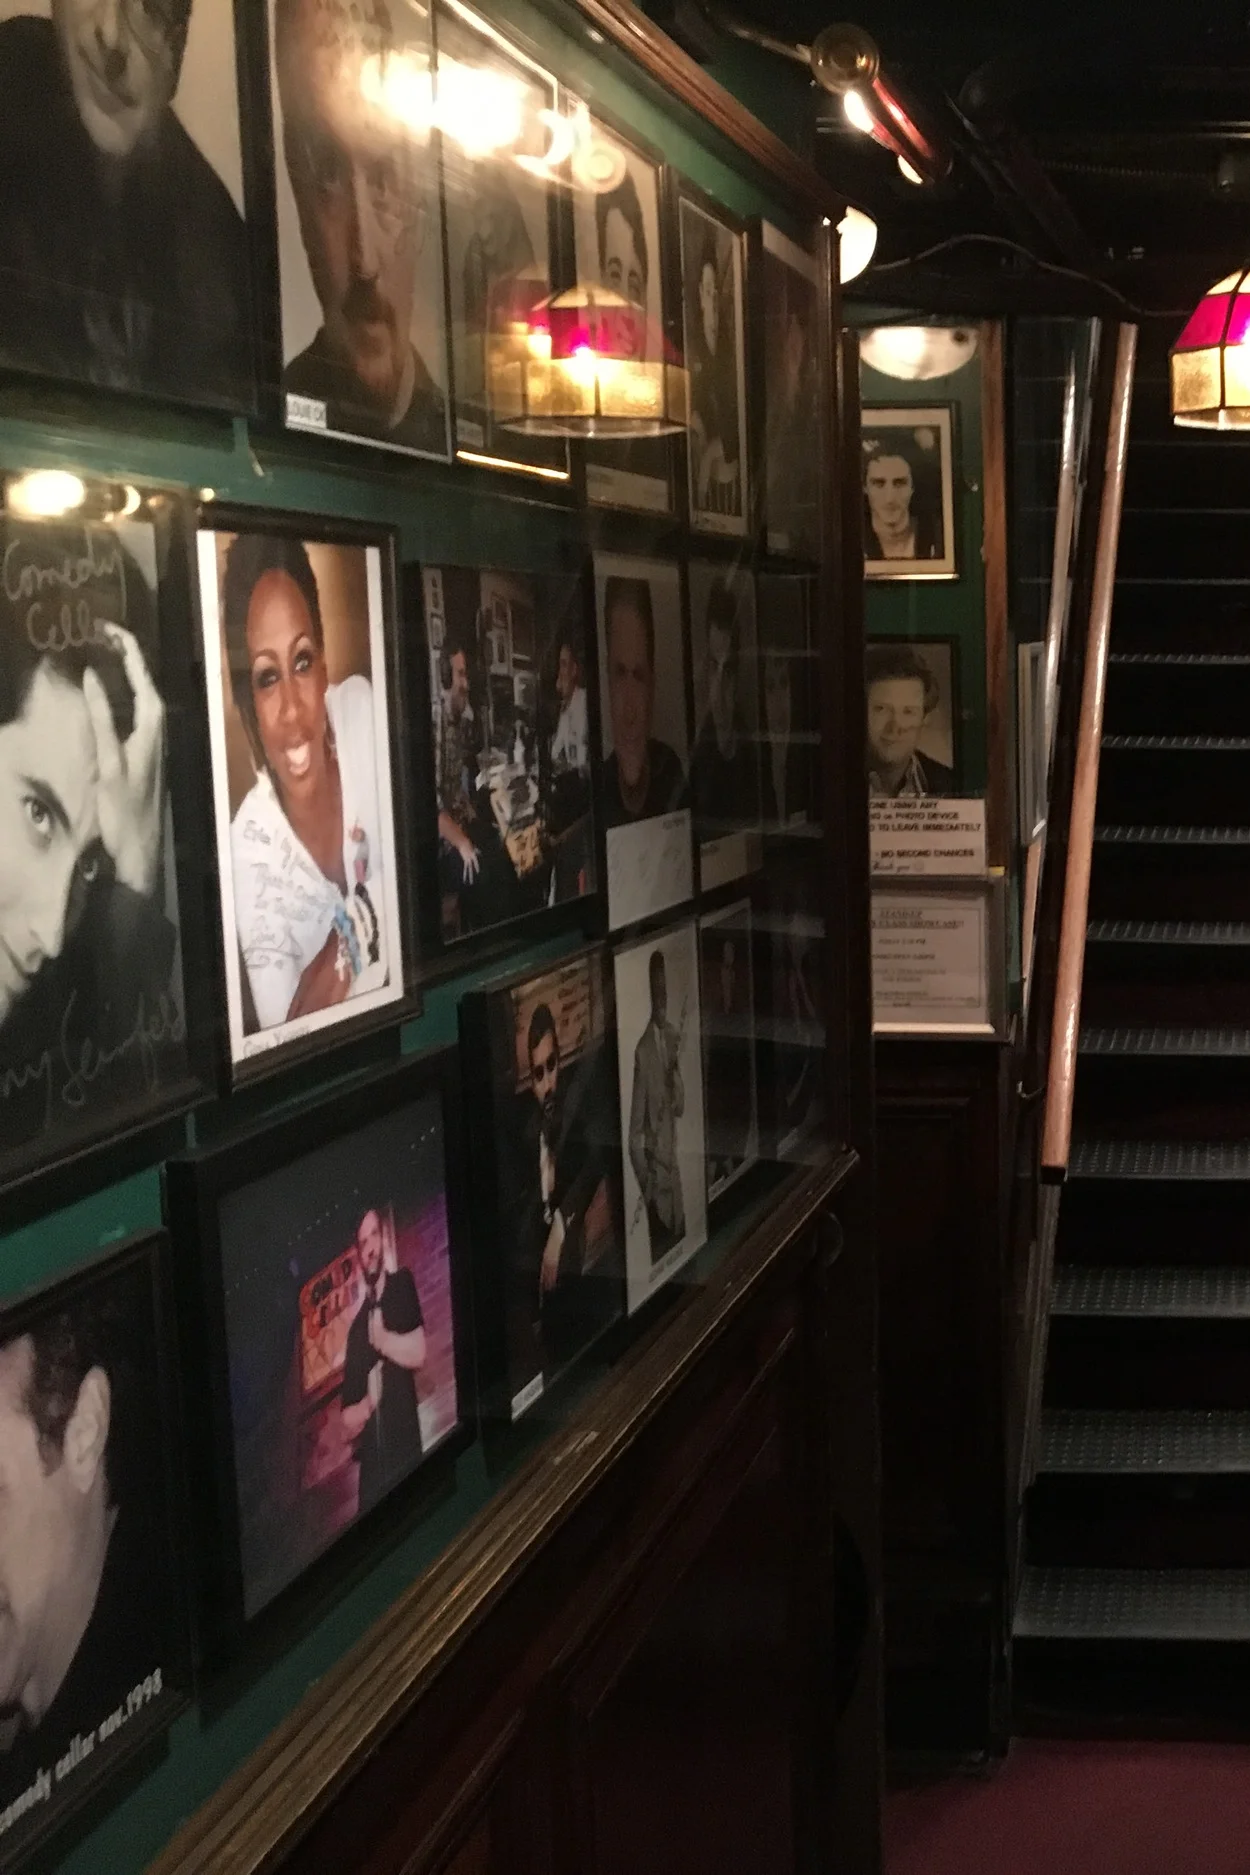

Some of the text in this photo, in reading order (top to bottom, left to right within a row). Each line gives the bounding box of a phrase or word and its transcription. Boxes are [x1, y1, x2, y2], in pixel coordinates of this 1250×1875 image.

[4, 525, 127, 621] Comedy
[895, 812, 925, 820] PHOTO
[927, 812, 960, 820] DEVICE
[891, 823, 919, 832] LEAVE
[922, 823, 981, 832] IMMEDIATELY
[896, 849, 931, 858] SECOND
[933, 848, 975, 858] CHANCES
[0, 1766, 51, 1835] omedy
[55, 1732, 96, 1782] cellar
